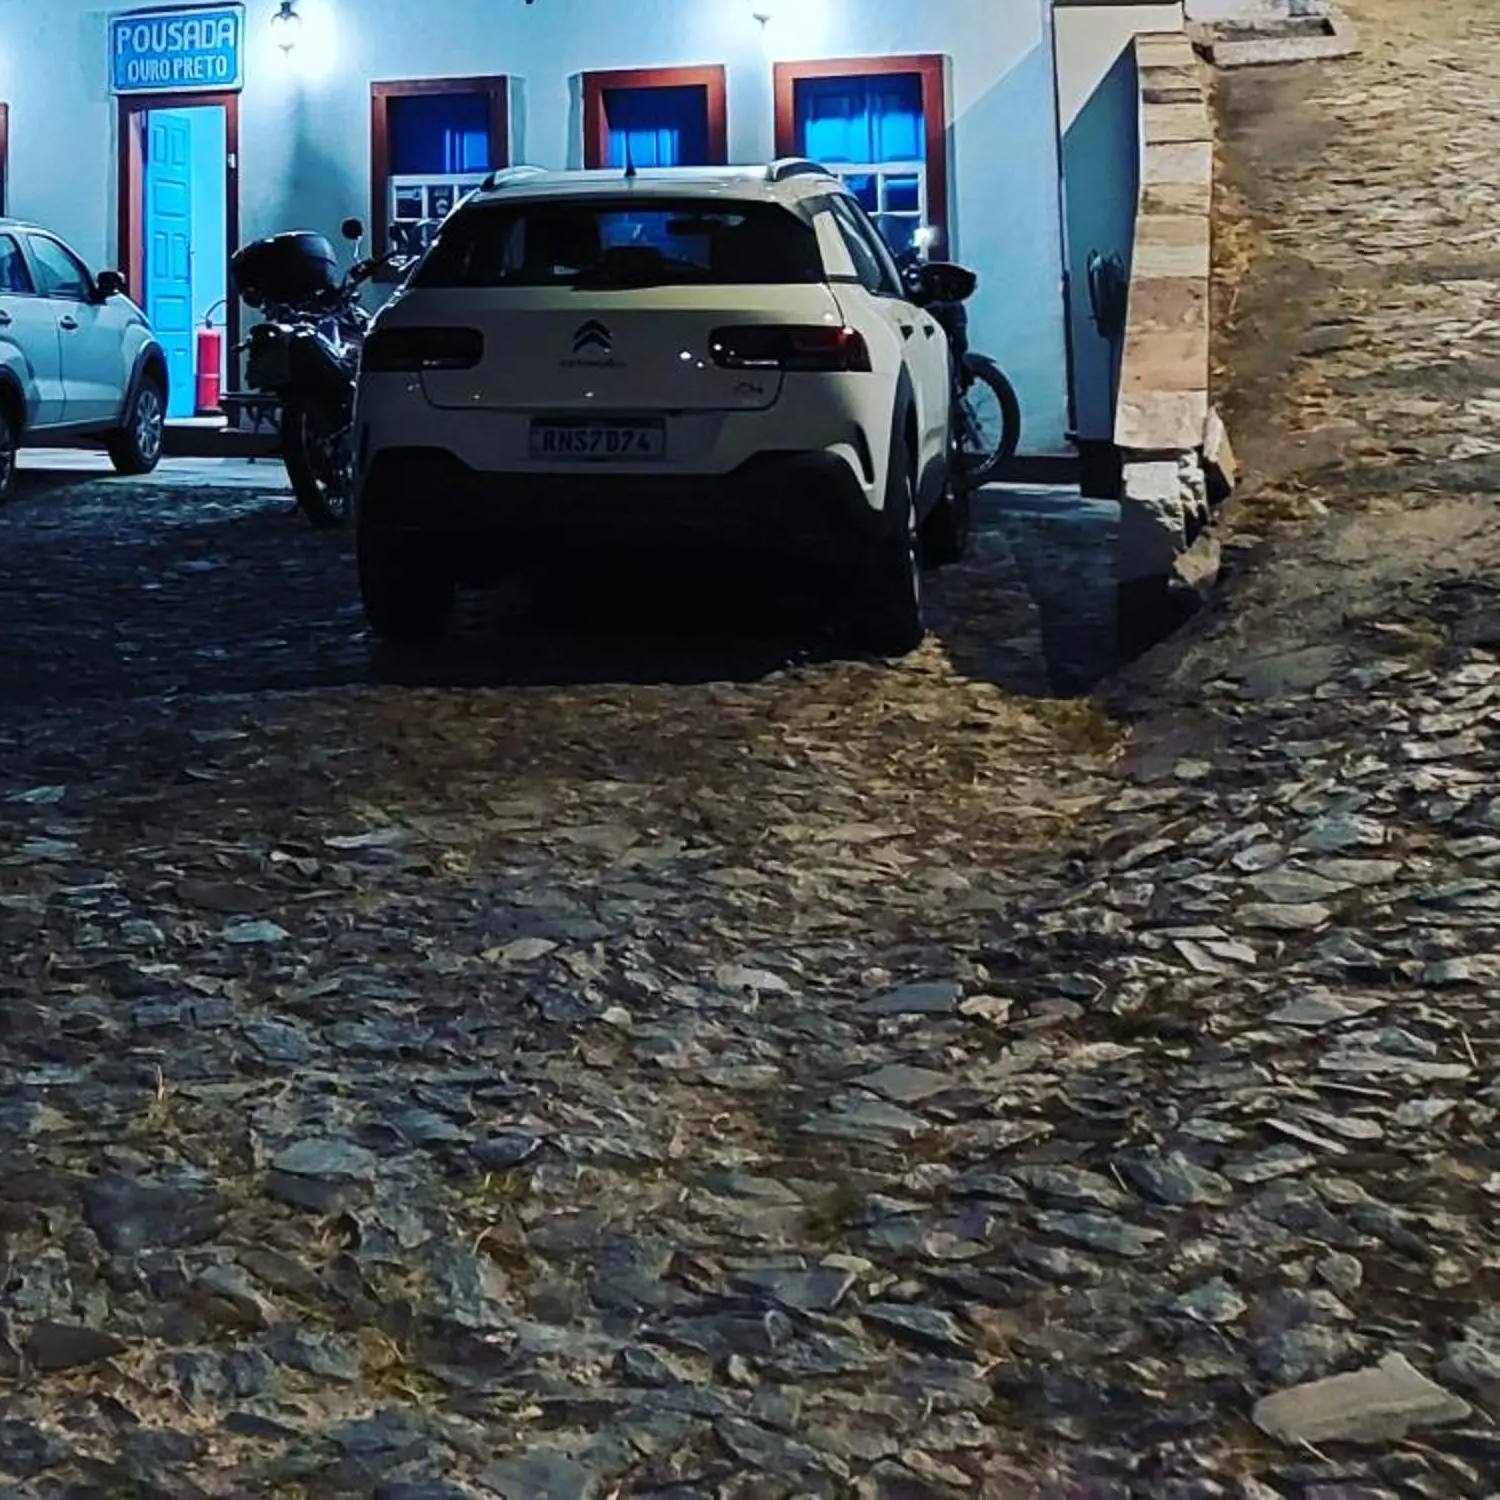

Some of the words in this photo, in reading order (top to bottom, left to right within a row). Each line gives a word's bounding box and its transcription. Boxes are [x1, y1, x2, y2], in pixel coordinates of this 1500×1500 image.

[116, 17, 235, 54] POUSADA
[127, 56, 171, 82] OURO
[173, 54, 228, 79] PRETO
